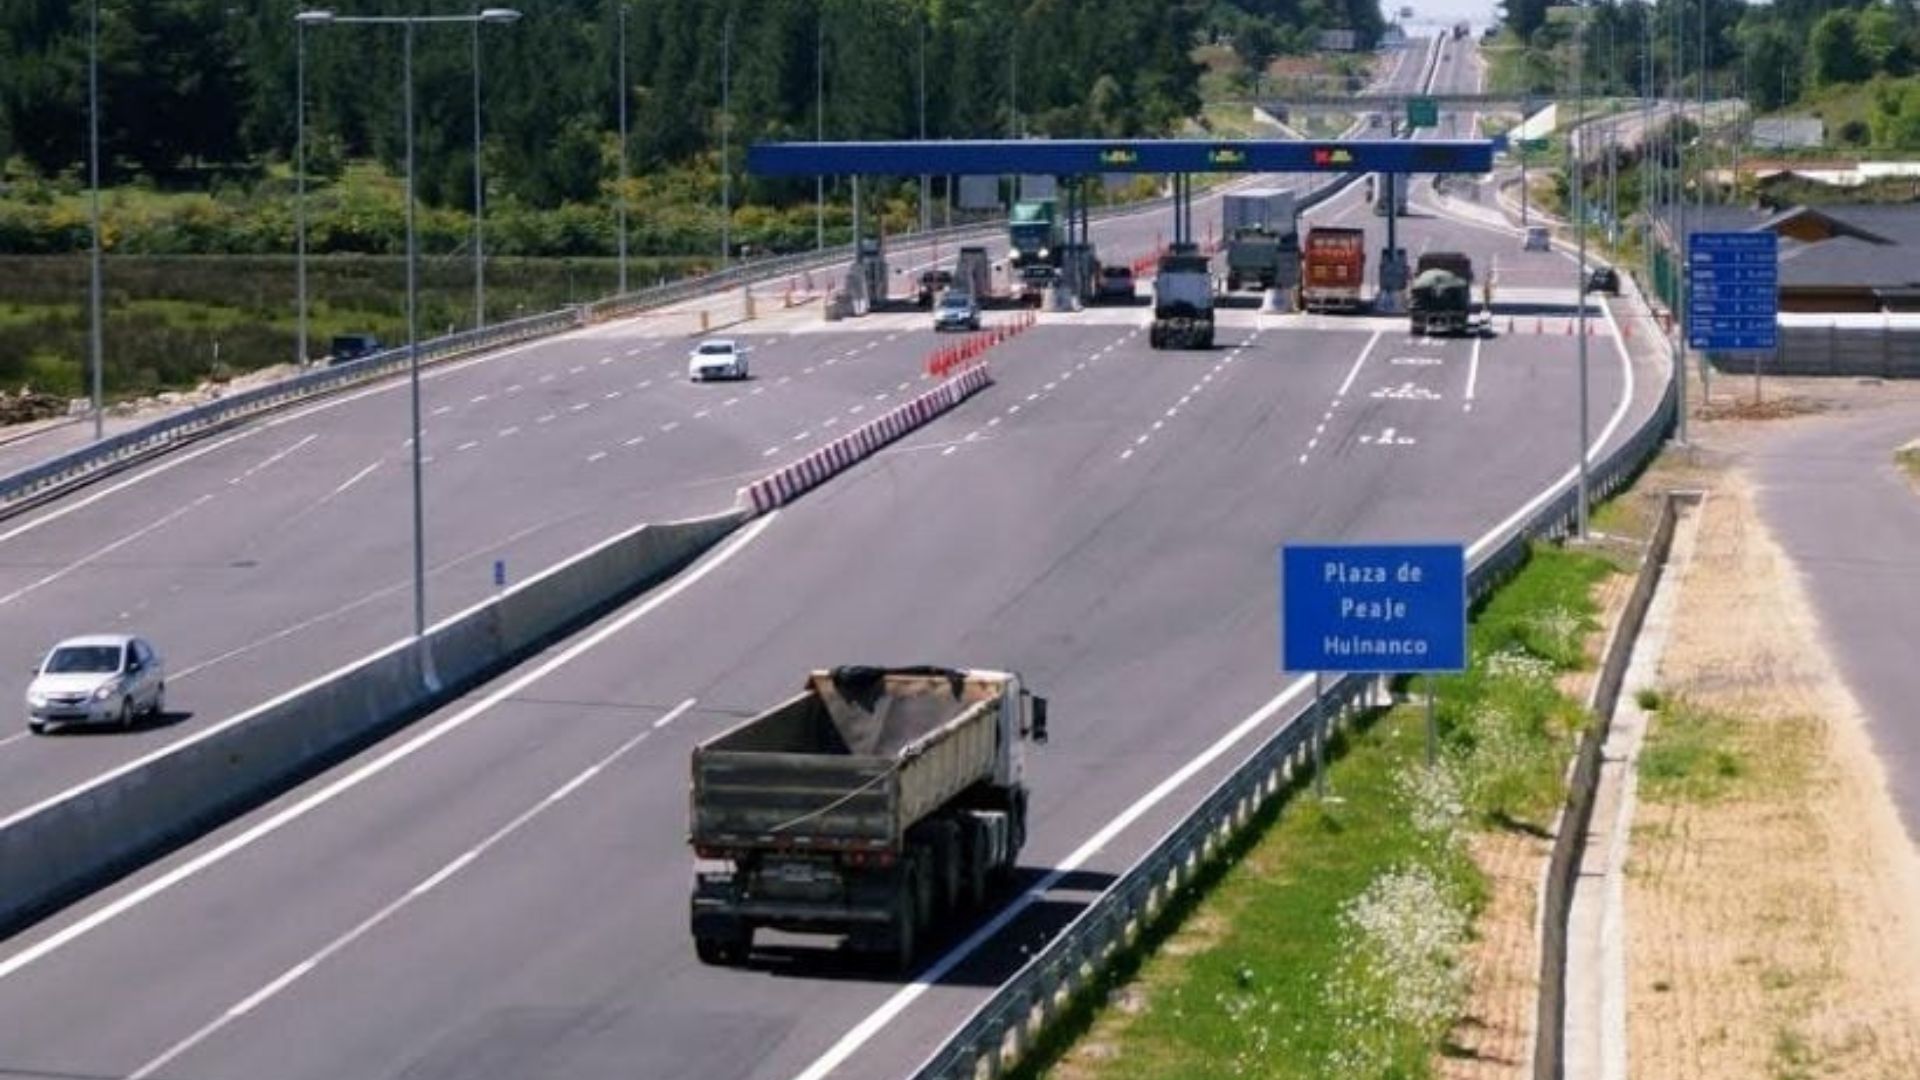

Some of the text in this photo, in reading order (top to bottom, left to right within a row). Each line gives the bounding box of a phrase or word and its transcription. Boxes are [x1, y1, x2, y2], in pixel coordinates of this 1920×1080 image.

[1324, 562, 1422, 582] Plaza de
[1341, 598, 1406, 621] Peaje
